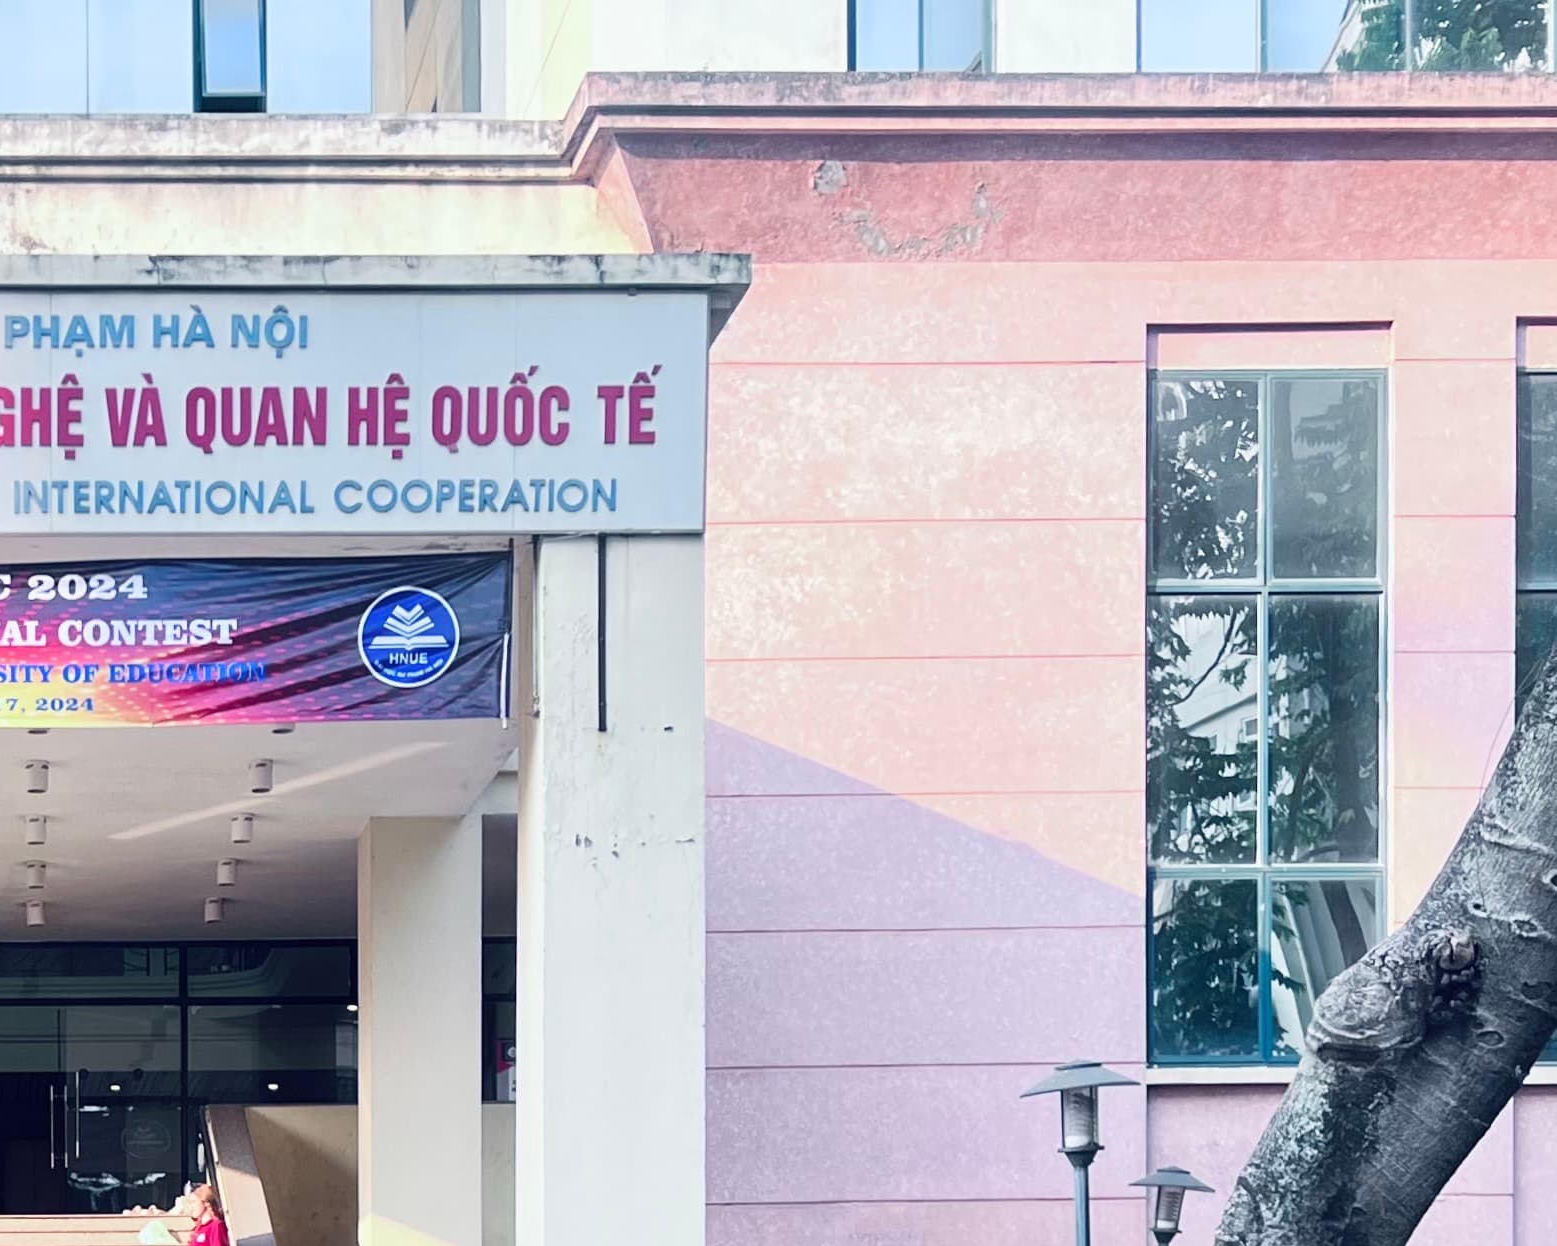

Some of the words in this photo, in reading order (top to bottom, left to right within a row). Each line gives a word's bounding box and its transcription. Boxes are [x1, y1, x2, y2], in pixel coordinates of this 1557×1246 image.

[4, 313, 136, 358] PHẠM
[152, 304, 216, 350] HÀ
[231, 304, 308, 359] NỘI
[106, 372, 170, 449] VÀ
[185, 385, 328, 452] QUAN
[347, 373, 412, 461] HỆ
[431, 365, 571, 453] QUỐC
[597, 363, 664, 446] TẾ
[13, 479, 315, 515] INTERNATIONAL
[333, 479, 618, 514] COOPERATION
[28, 573, 148, 601] 2024
[58, 618, 238, 647] CONTEST
[62, 664, 99, 684] OF
[109, 660, 268, 685] EDUCATION
[389, 652, 429, 665] HNUE
[35, 697, 95, 712] 2024
